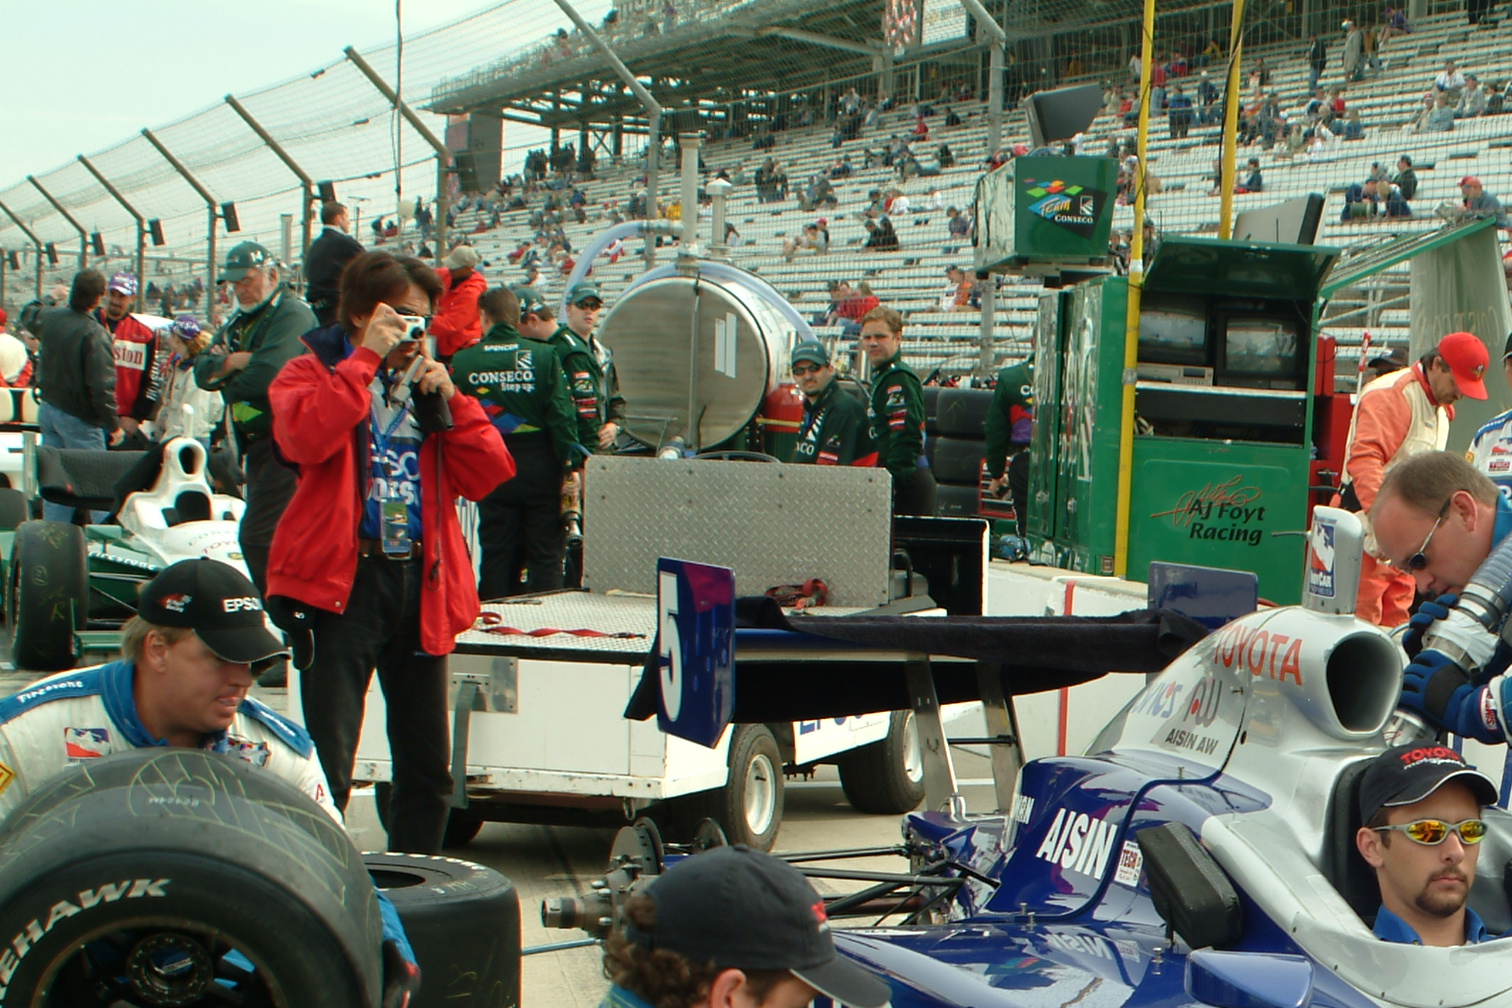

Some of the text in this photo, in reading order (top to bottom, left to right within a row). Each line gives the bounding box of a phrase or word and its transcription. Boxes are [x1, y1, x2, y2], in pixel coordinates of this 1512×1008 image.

[114, 346, 144, 366] ston
[468, 370, 533, 385] CONSECO
[1217, 502, 1266, 524] Foyt
[1189, 522, 1263, 546] Racing
[222, 596, 263, 613] EPSO
[659, 569, 683, 723] 5
[1211, 623, 1303, 686] TOYOTA
[1164, 727, 1219, 756] AISIN AW
[1036, 808, 1118, 880] AISIN
[0, 878, 172, 995] EHAWK
